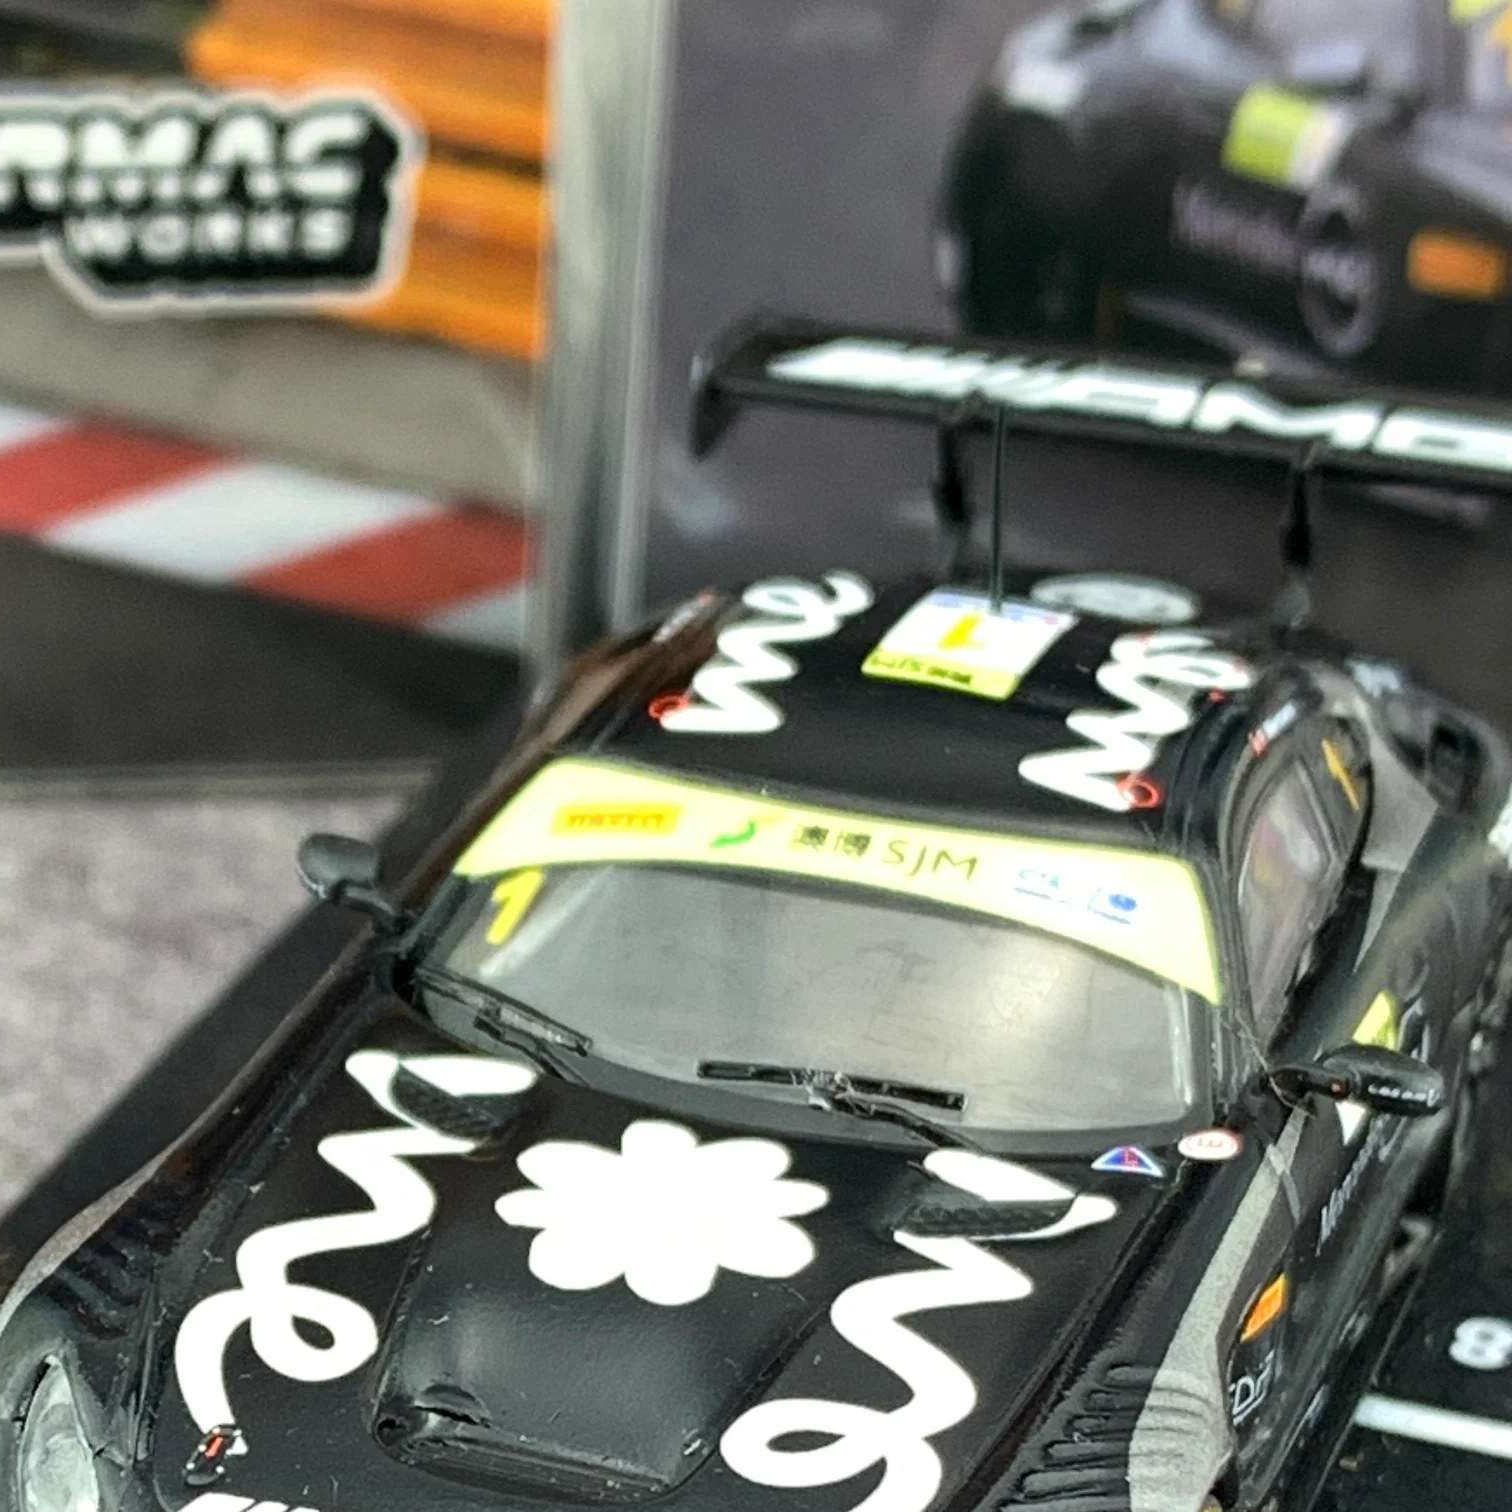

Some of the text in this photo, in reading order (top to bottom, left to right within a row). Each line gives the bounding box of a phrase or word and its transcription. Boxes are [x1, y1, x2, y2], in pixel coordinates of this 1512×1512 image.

[65, 207, 353, 262] WORKS
[883, 839, 979, 881] SJM
[487, 869, 544, 945] 1
